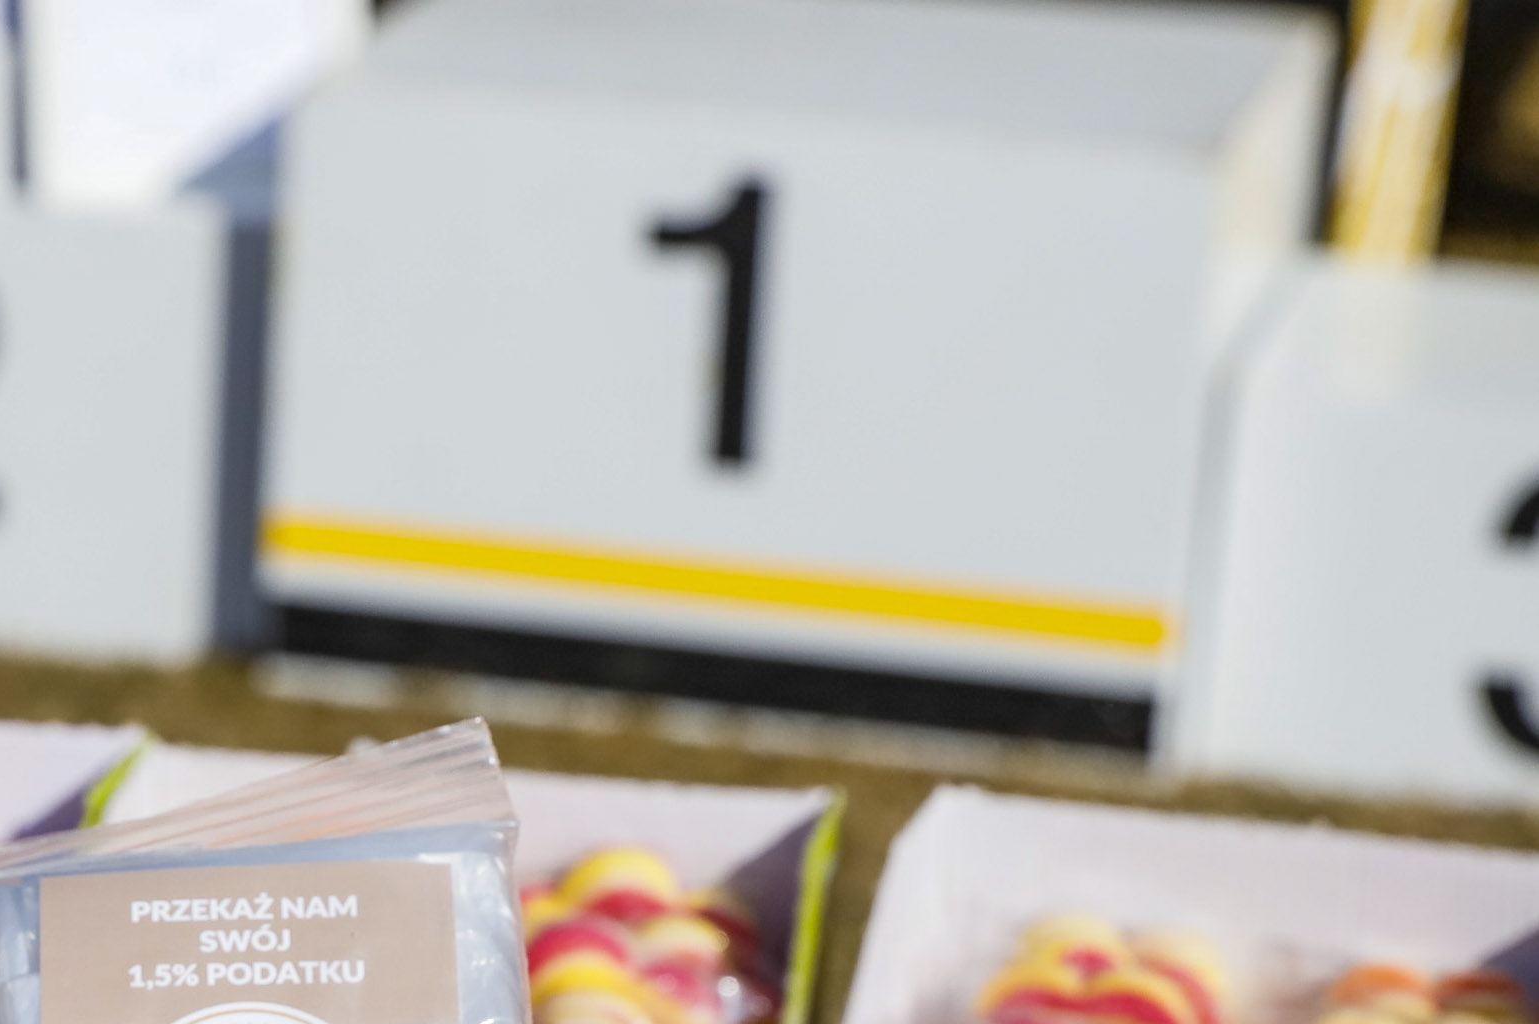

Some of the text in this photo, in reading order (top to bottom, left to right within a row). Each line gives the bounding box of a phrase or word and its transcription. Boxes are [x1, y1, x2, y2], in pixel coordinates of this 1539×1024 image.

[646, 178, 771, 468] 1
[130, 893, 358, 923] PRZEKAŻ NAM
[199, 924, 291, 953] SWÓJ
[128, 960, 365, 990] 1,5% PODATKU
